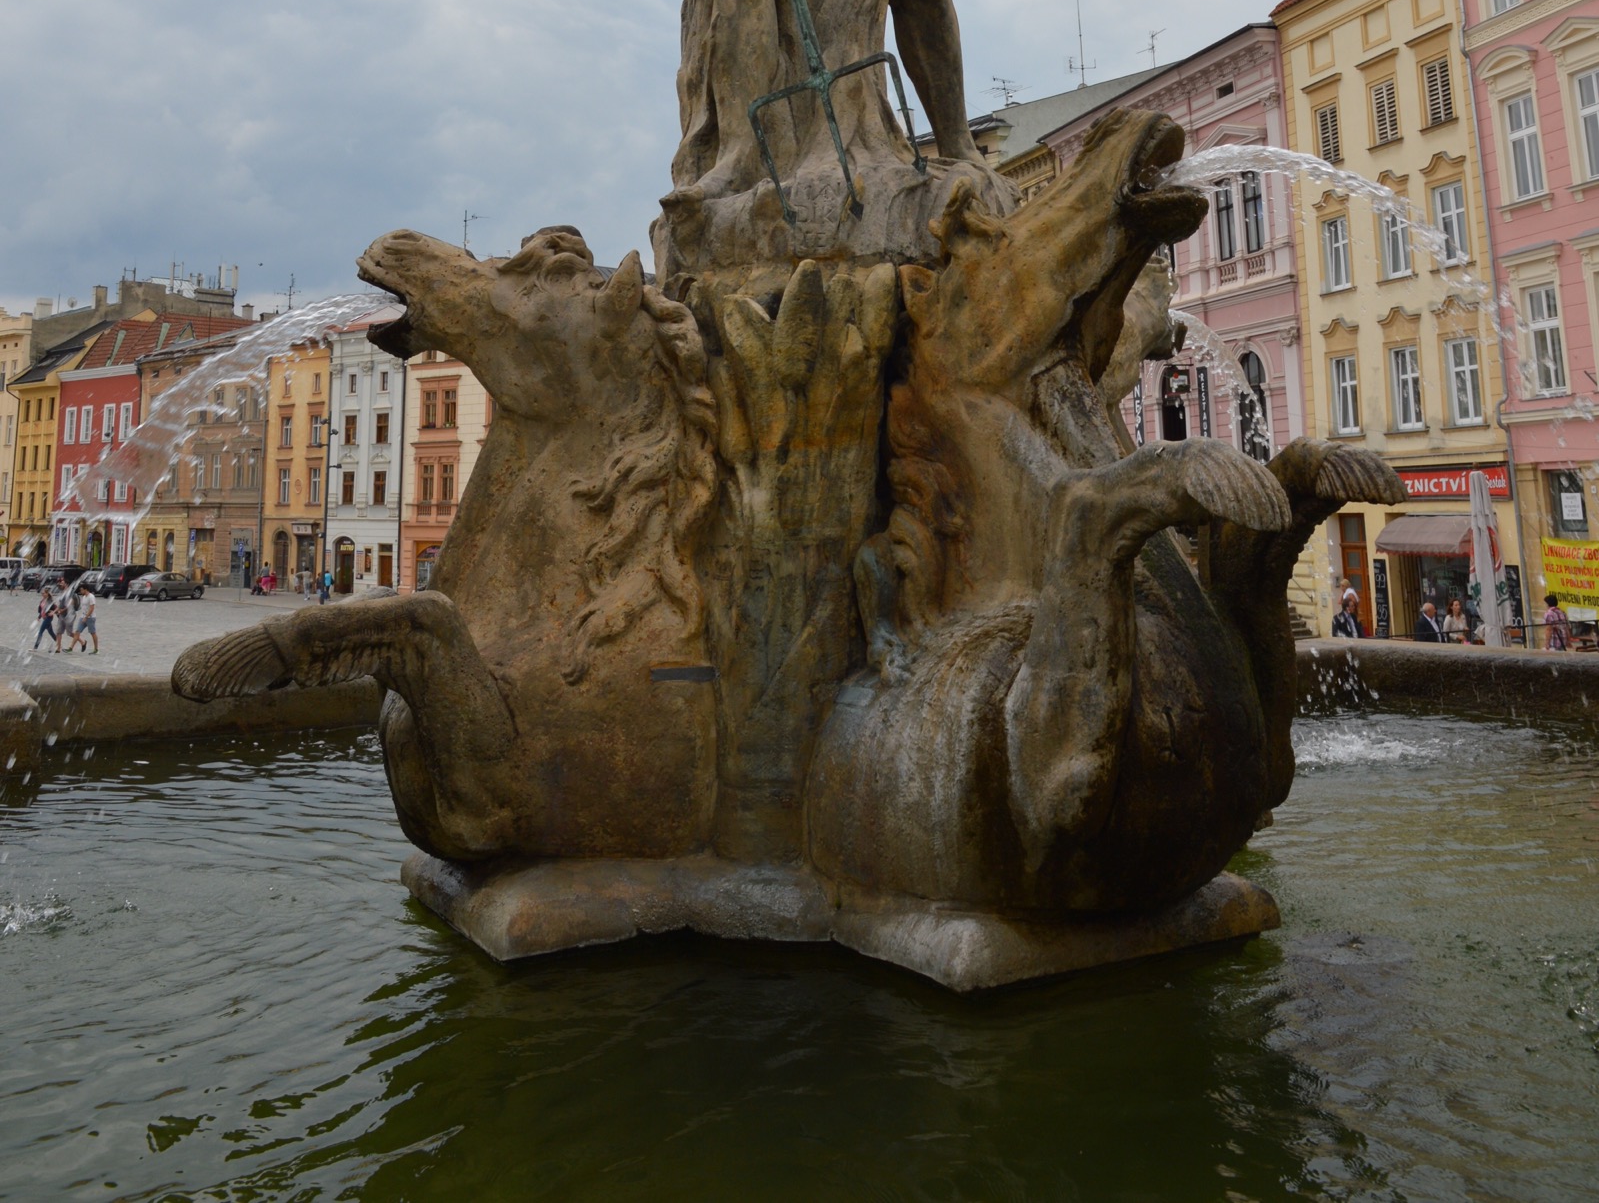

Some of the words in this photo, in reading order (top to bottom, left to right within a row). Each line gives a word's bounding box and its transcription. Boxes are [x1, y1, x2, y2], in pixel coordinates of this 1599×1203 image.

[1405, 471, 1466, 493] ZNICTVÍ
[1543, 544, 1581, 559] LIKVIDACE
[1556, 564, 1563, 574] ZA
